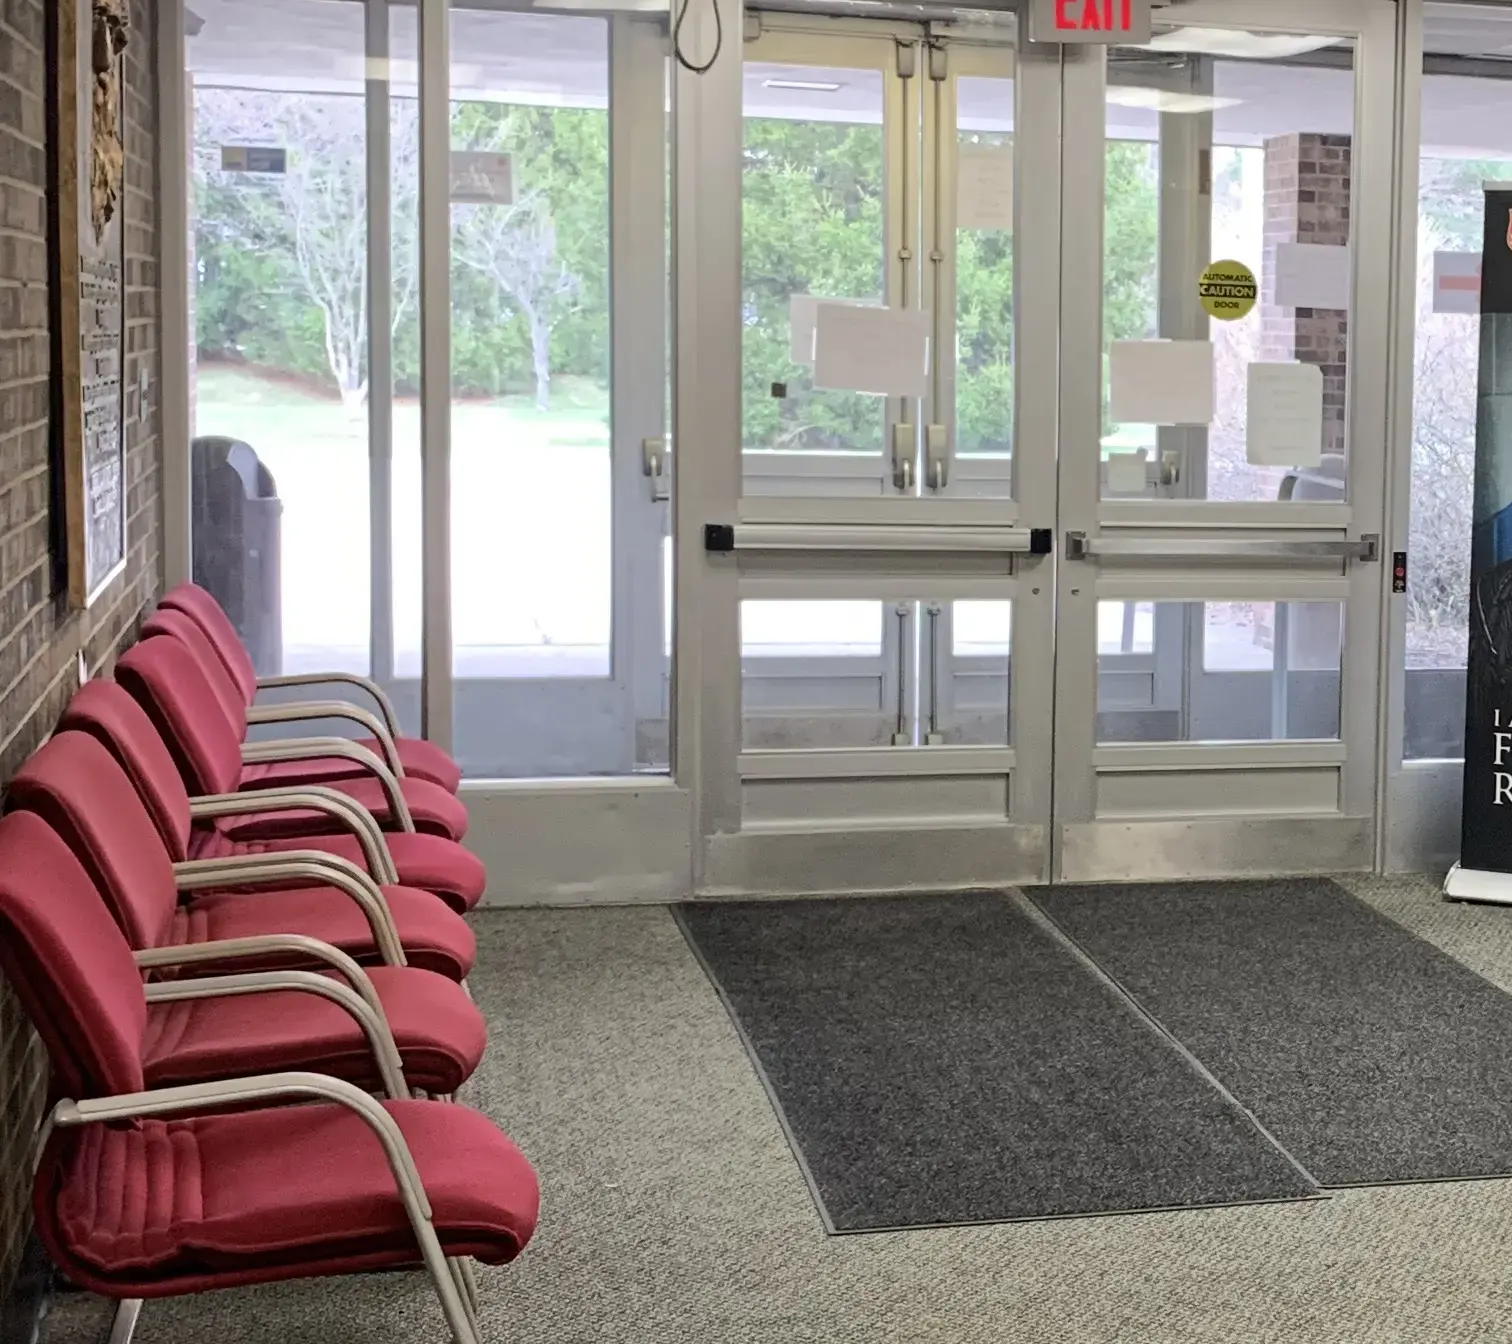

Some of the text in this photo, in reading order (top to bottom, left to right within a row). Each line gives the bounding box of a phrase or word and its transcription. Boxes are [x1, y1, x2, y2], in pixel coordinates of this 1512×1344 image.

[1203, 273, 1253, 283] AUTOMATIC
[1200, 285, 1254, 297] CAUTION
[1213, 301, 1240, 309] DOOR
[1493, 709, 1501, 727] I
